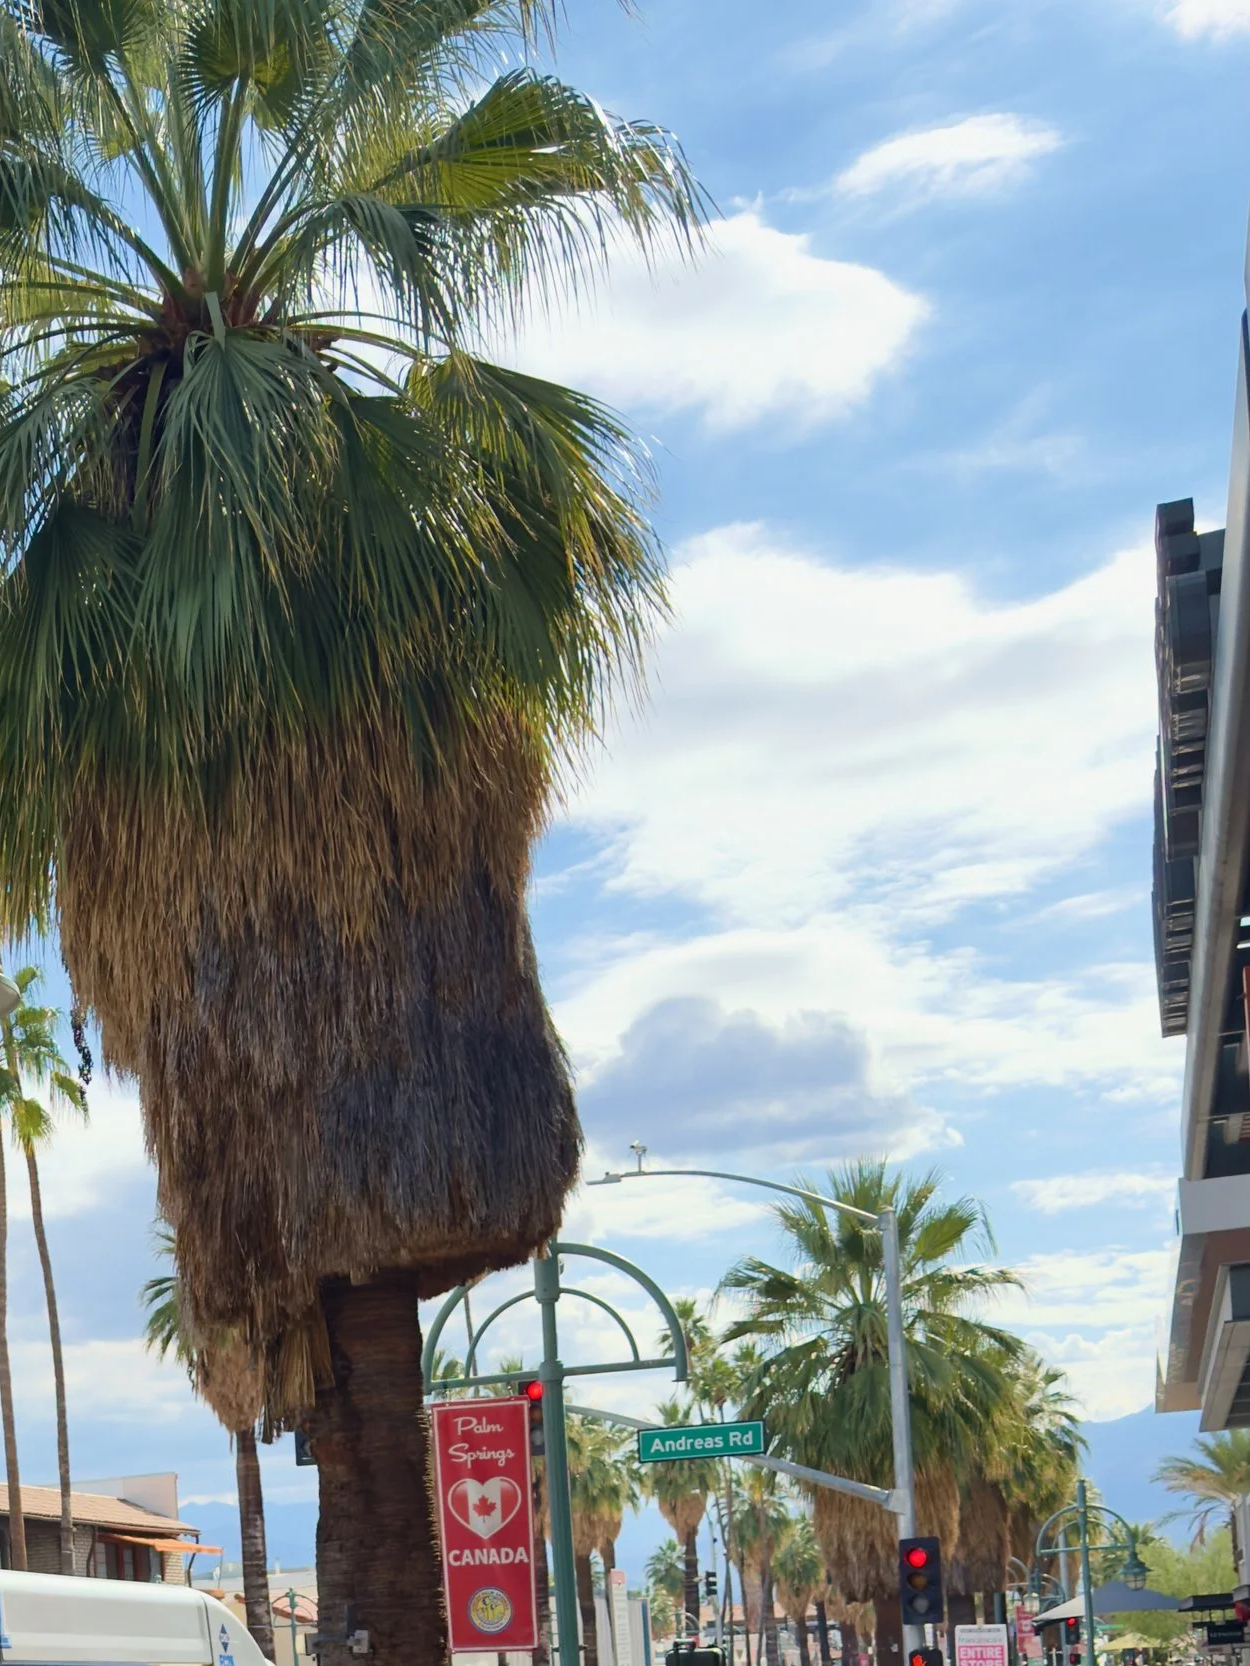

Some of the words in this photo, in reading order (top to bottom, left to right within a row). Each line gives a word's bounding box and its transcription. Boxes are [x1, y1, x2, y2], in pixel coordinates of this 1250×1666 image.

[454, 1416, 503, 1435] Palm
[651, 1436, 724, 1453] Andreas
[729, 1431, 753, 1447] Rd
[448, 1443, 515, 1468] Springs
[448, 1547, 529, 1566] CANADA
[959, 1647, 1003, 1659] ENTIRE
